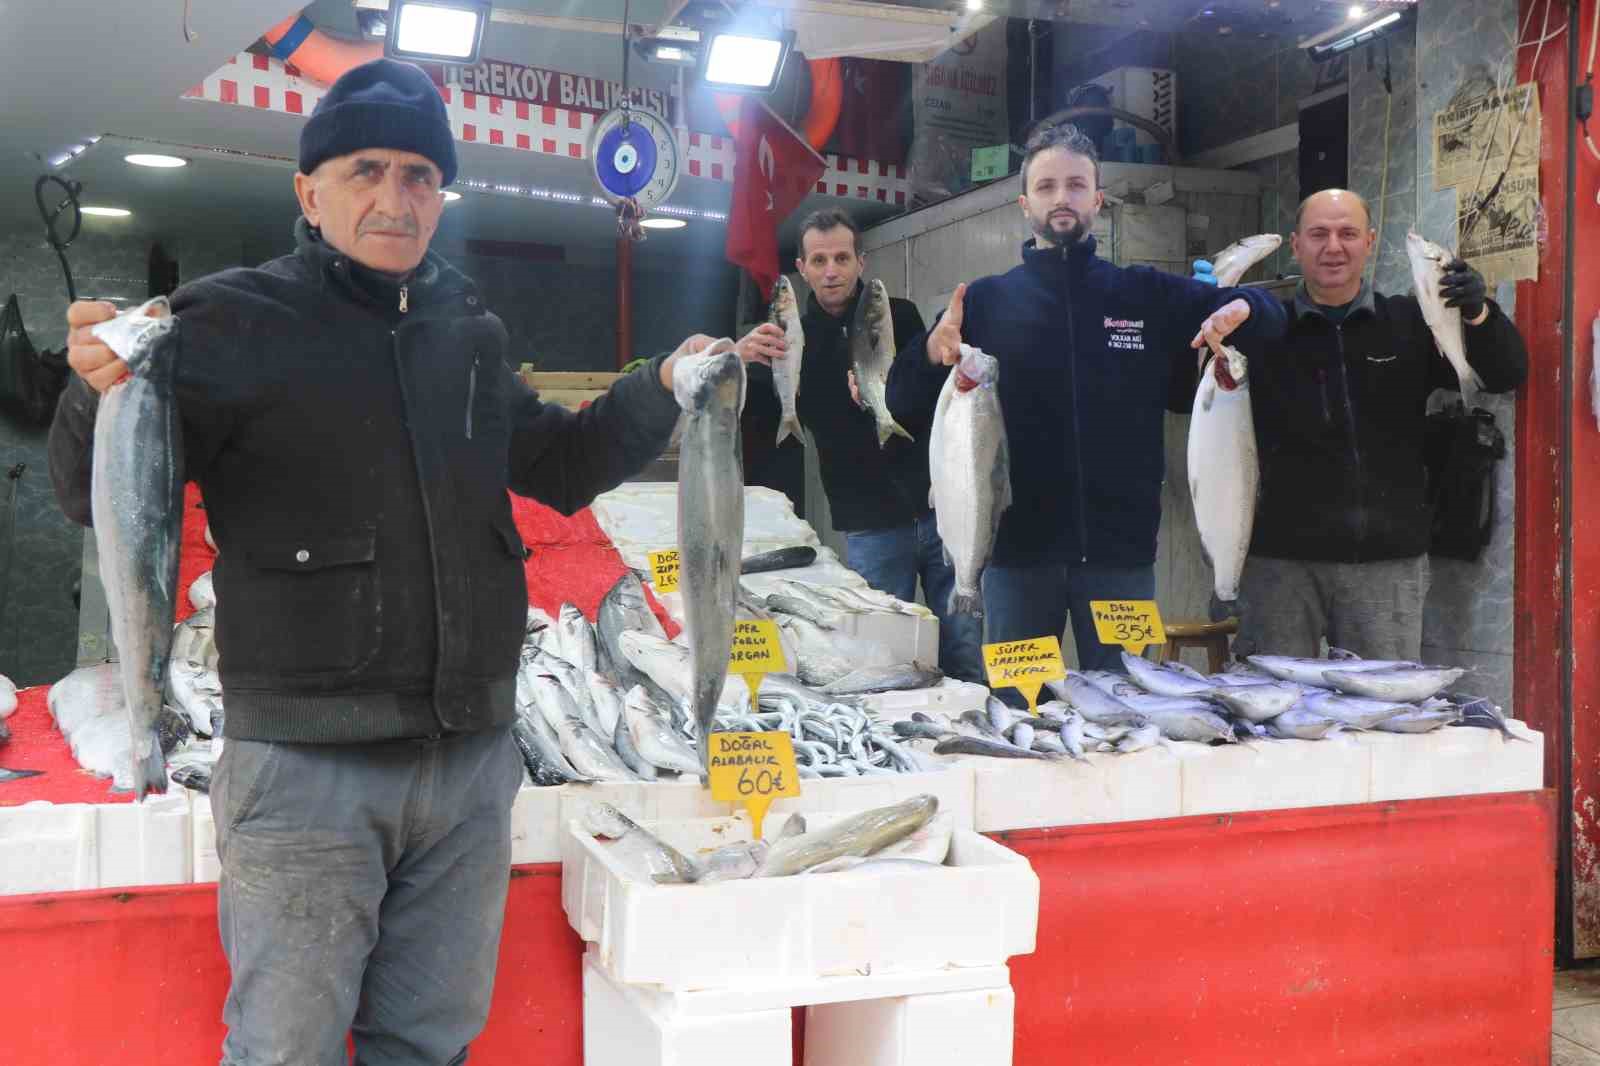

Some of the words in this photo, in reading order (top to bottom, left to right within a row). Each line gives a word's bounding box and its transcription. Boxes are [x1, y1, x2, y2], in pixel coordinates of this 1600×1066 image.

[657, 551, 680, 564] DOĞ
[735, 623, 760, 633] PER
[720, 736, 774, 753] DOĞAL
